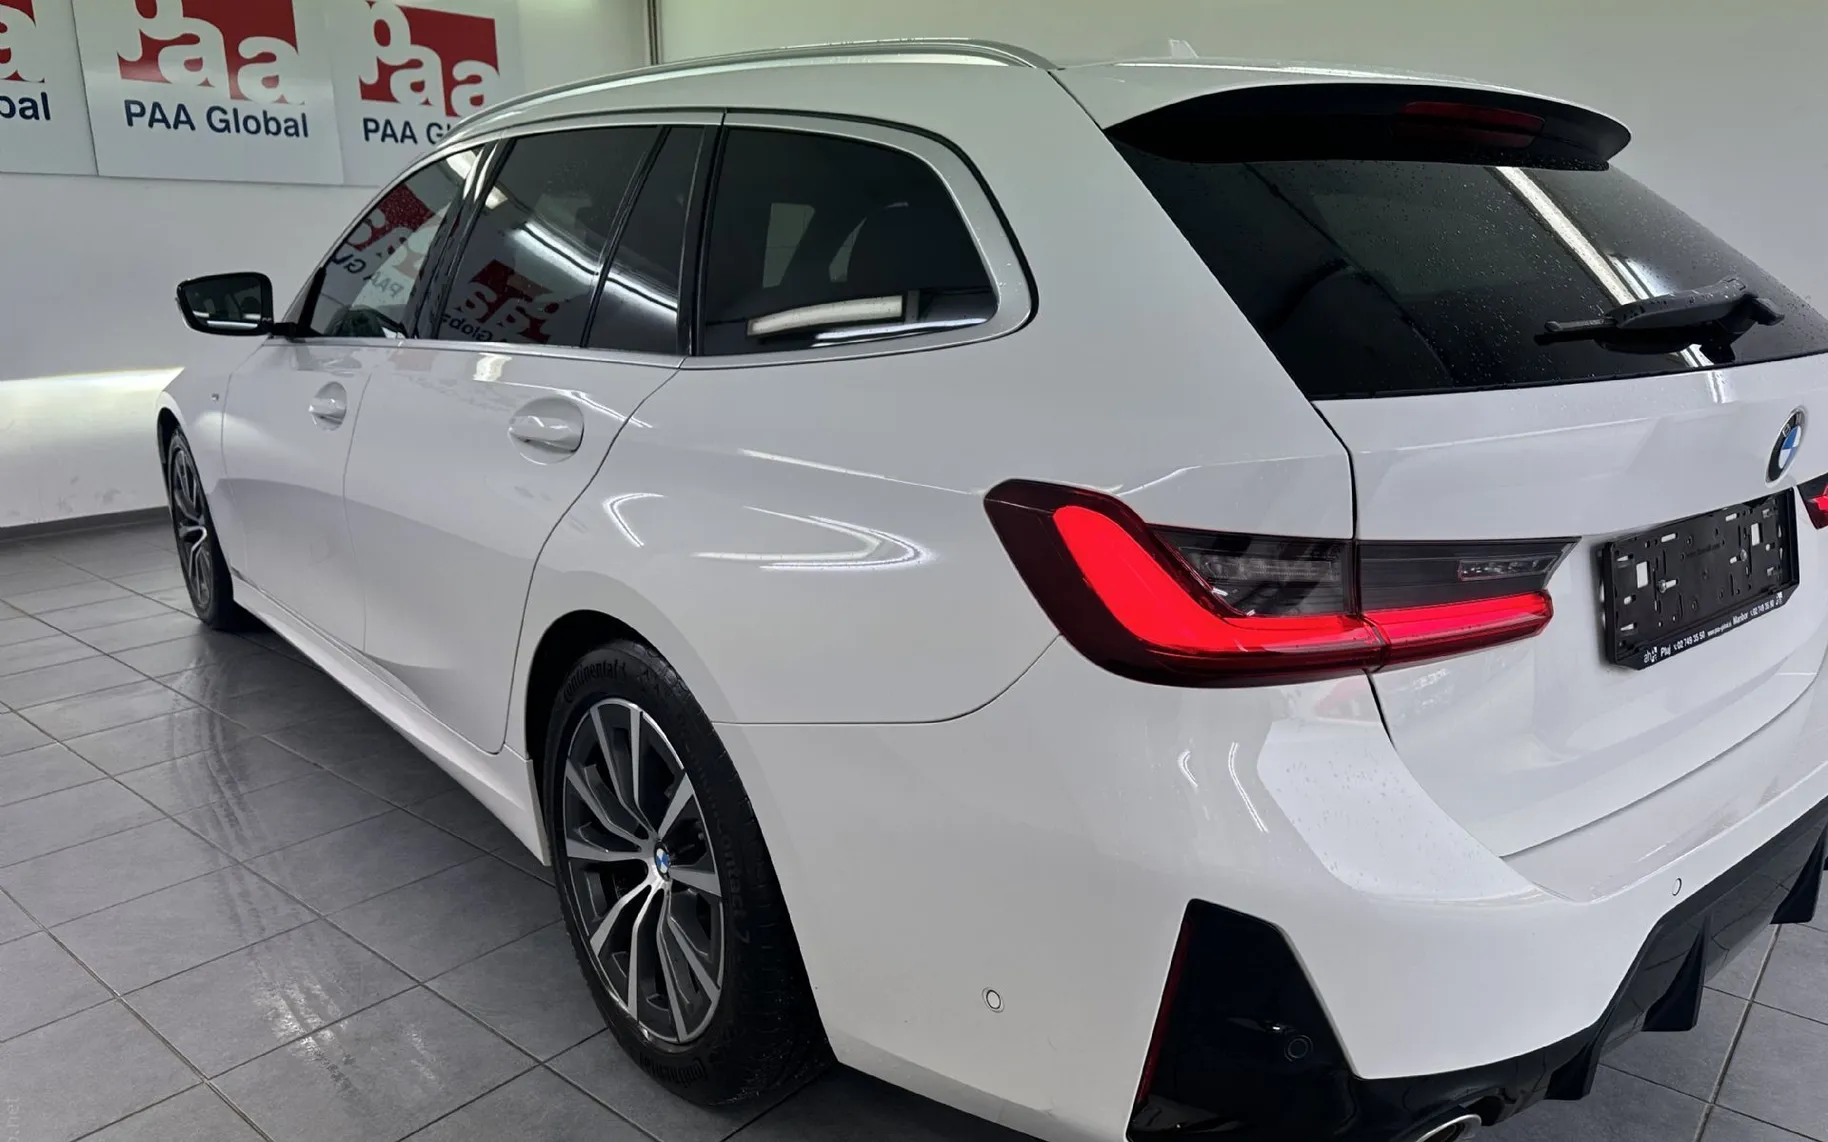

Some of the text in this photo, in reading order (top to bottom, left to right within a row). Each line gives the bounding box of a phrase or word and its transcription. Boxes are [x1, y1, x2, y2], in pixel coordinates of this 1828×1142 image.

[124, 99, 309, 138] PAA Global
[363, 117, 418, 145] PAA
